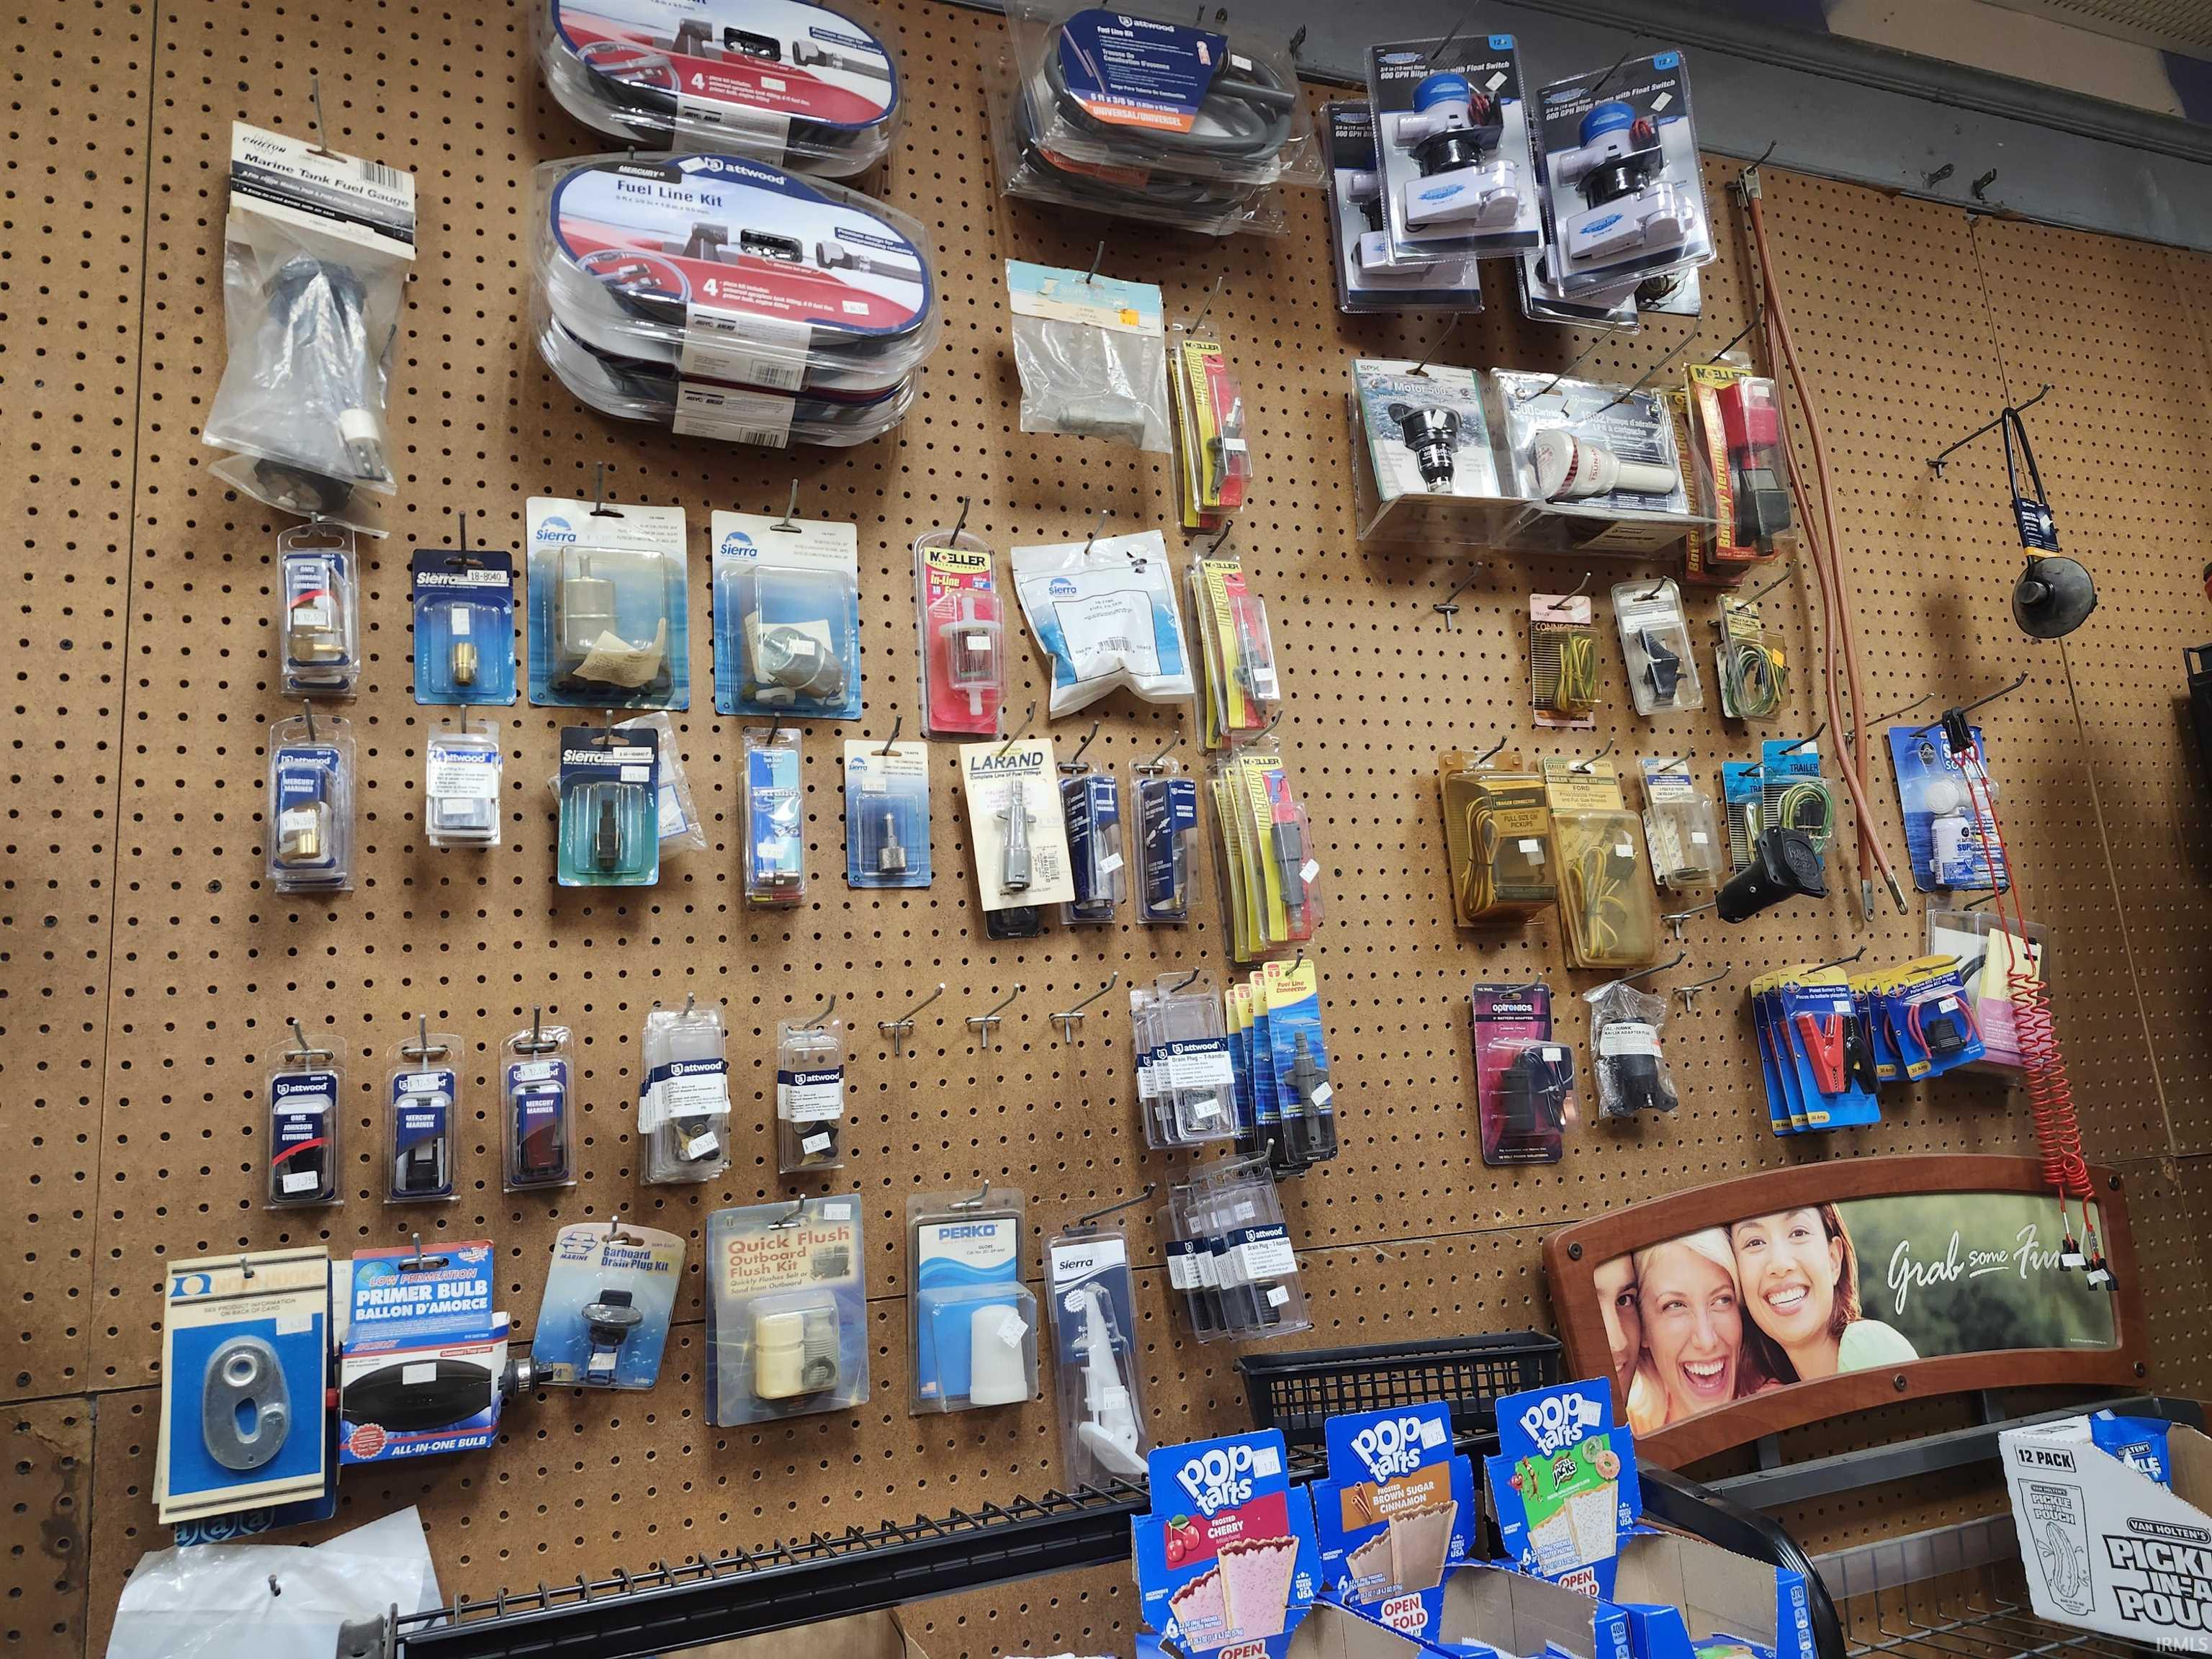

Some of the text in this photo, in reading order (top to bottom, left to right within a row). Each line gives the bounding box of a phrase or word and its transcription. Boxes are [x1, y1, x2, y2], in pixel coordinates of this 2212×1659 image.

[1133, 19, 1175, 32] attwood
[691, 73, 705, 90] 4
[1560, 108, 1575, 117] GPH
[1575, 102, 1593, 114] Bilge
[1615, 91, 1630, 100] with
[1632, 86, 1650, 96] Float
[1651, 79, 1676, 91] Switch
[619, 165, 659, 177] MERCURY
[725, 164, 785, 186] attwood
[245, 153, 409, 207] Marine Tank Fuel Gauge
[616, 179, 652, 196] Fuel
[658, 185, 693, 202] Line
[700, 192, 723, 208] Kit
[703, 278, 719, 297] 4
[1394, 382, 1447, 395] Motor 500
[1514, 403, 1534, 415] 500
[1607, 416, 1628, 426] Pompe
[1717, 495, 1732, 548] Battery
[535, 528, 577, 543] Sierra
[720, 544, 757, 559] Sierra
[930, 552, 985, 567] MOELLER
[416, 572, 458, 585] Sierra
[930, 574, 960, 587] In-Line
[563, 750, 604, 763] Sierra
[971, 752, 1043, 771] LARAND
[1789, 763, 1818, 773] TRAILER
[1276, 985, 1307, 994] Connector
[1183, 1041, 1219, 1053] attwood
[684, 1061, 723, 1074] attwood
[806, 1071, 840, 1082] attwood
[289, 1083, 328, 1093] attwood
[526, 1099, 554, 1107] MERCURY
[526, 1105, 554, 1115] MARINER
[405, 1113, 436, 1122] MERCURY
[405, 1120, 434, 1129] MARINER
[938, 1224, 995, 1240] PERKO
[1255, 1227, 1283, 1240] attwood
[728, 1226, 850, 1254] Quick Flush
[603, 1247, 651, 1259] Garboard
[730, 1246, 806, 1267] Outboard
[601, 1257, 669, 1271] Drain Plug Kit
[730, 1260, 798, 1278] Flush Kit
[369, 1268, 477, 1287] LOW PERMEATION
[731, 1278, 757, 1287] Quickly
[758, 1274, 784, 1283] Flushes
[1887, 1230, 1965, 1316] Grab
[1969, 1249, 2009, 1265] some
[768, 1280, 801, 1289] Outboard
[356, 1280, 488, 1307] PRIMER BULB
[218, 1298, 296, 1312] PRODUCT INFORMATION
[356, 1297, 487, 1321] BALLON D'AMORCE
[391, 1438, 456, 1456] ALL-IN-ONE
[458, 1436, 487, 1447] BULB
[1537, 1421, 1583, 1456] tarts
[1370, 1448, 1420, 1483] tarts
[1555, 1457, 1573, 1470] APPLE
[2018, 1449, 2072, 1468] 12 PACK
[1553, 1462, 1576, 1491] JACKS
[1196, 1478, 1252, 1516] tarts
[1372, 1481, 1434, 1506] BROWN SUGAR
[1377, 1483, 1401, 1496] FROSTED
[2044, 1486, 2067, 1496] HOLTEN'S
[1380, 1494, 1427, 1514] CINNAMON
[2031, 1493, 2072, 1509] PICKLE
[1211, 1515, 1236, 1527] FROSTED
[1620, 1516, 1632, 1527] USA
[2033, 1508, 2076, 1525] POUCH
[1207, 1520, 1244, 1539] CHERRY
[2131, 1521, 2207, 1540] VAN HOLTEN'S
[1523, 1548, 1531, 1566] 6
[1338, 1575, 1348, 1590] 6
[1560, 1570, 1592, 1589] OPEN
[1297, 1591, 1313, 1599] USA
[1791, 1586, 1803, 1598] 370
[1384, 1596, 1419, 1617] OPEN
[1165, 1617, 1178, 1639] 6
[1393, 1612, 1426, 1629] FOLD
[1612, 1622, 1624, 1634] 400
[1220, 1642, 1263, 1659] OPEN
